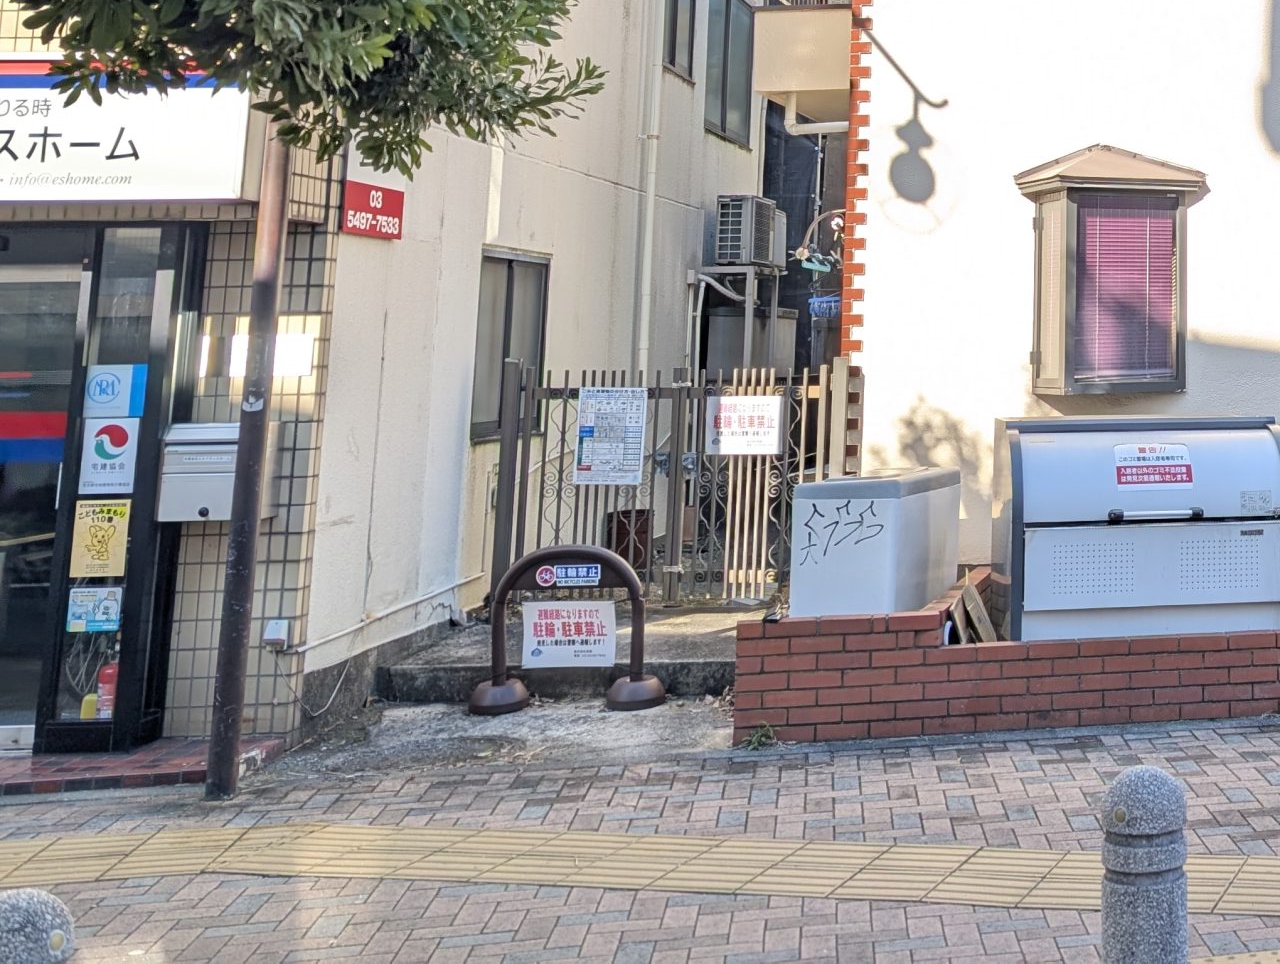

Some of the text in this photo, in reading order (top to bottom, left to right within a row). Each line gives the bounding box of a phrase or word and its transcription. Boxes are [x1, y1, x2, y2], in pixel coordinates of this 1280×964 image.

[9, 173, 132, 188] info@eshome.com
[369, 190, 383, 209] 03
[347, 210, 400, 235] 5497-7533
[78, 508, 126, 519] こどもみまもり
[556, 567, 598, 578] 駐輪禁止
[533, 621, 607, 637] 駐輪・駐車禁止
